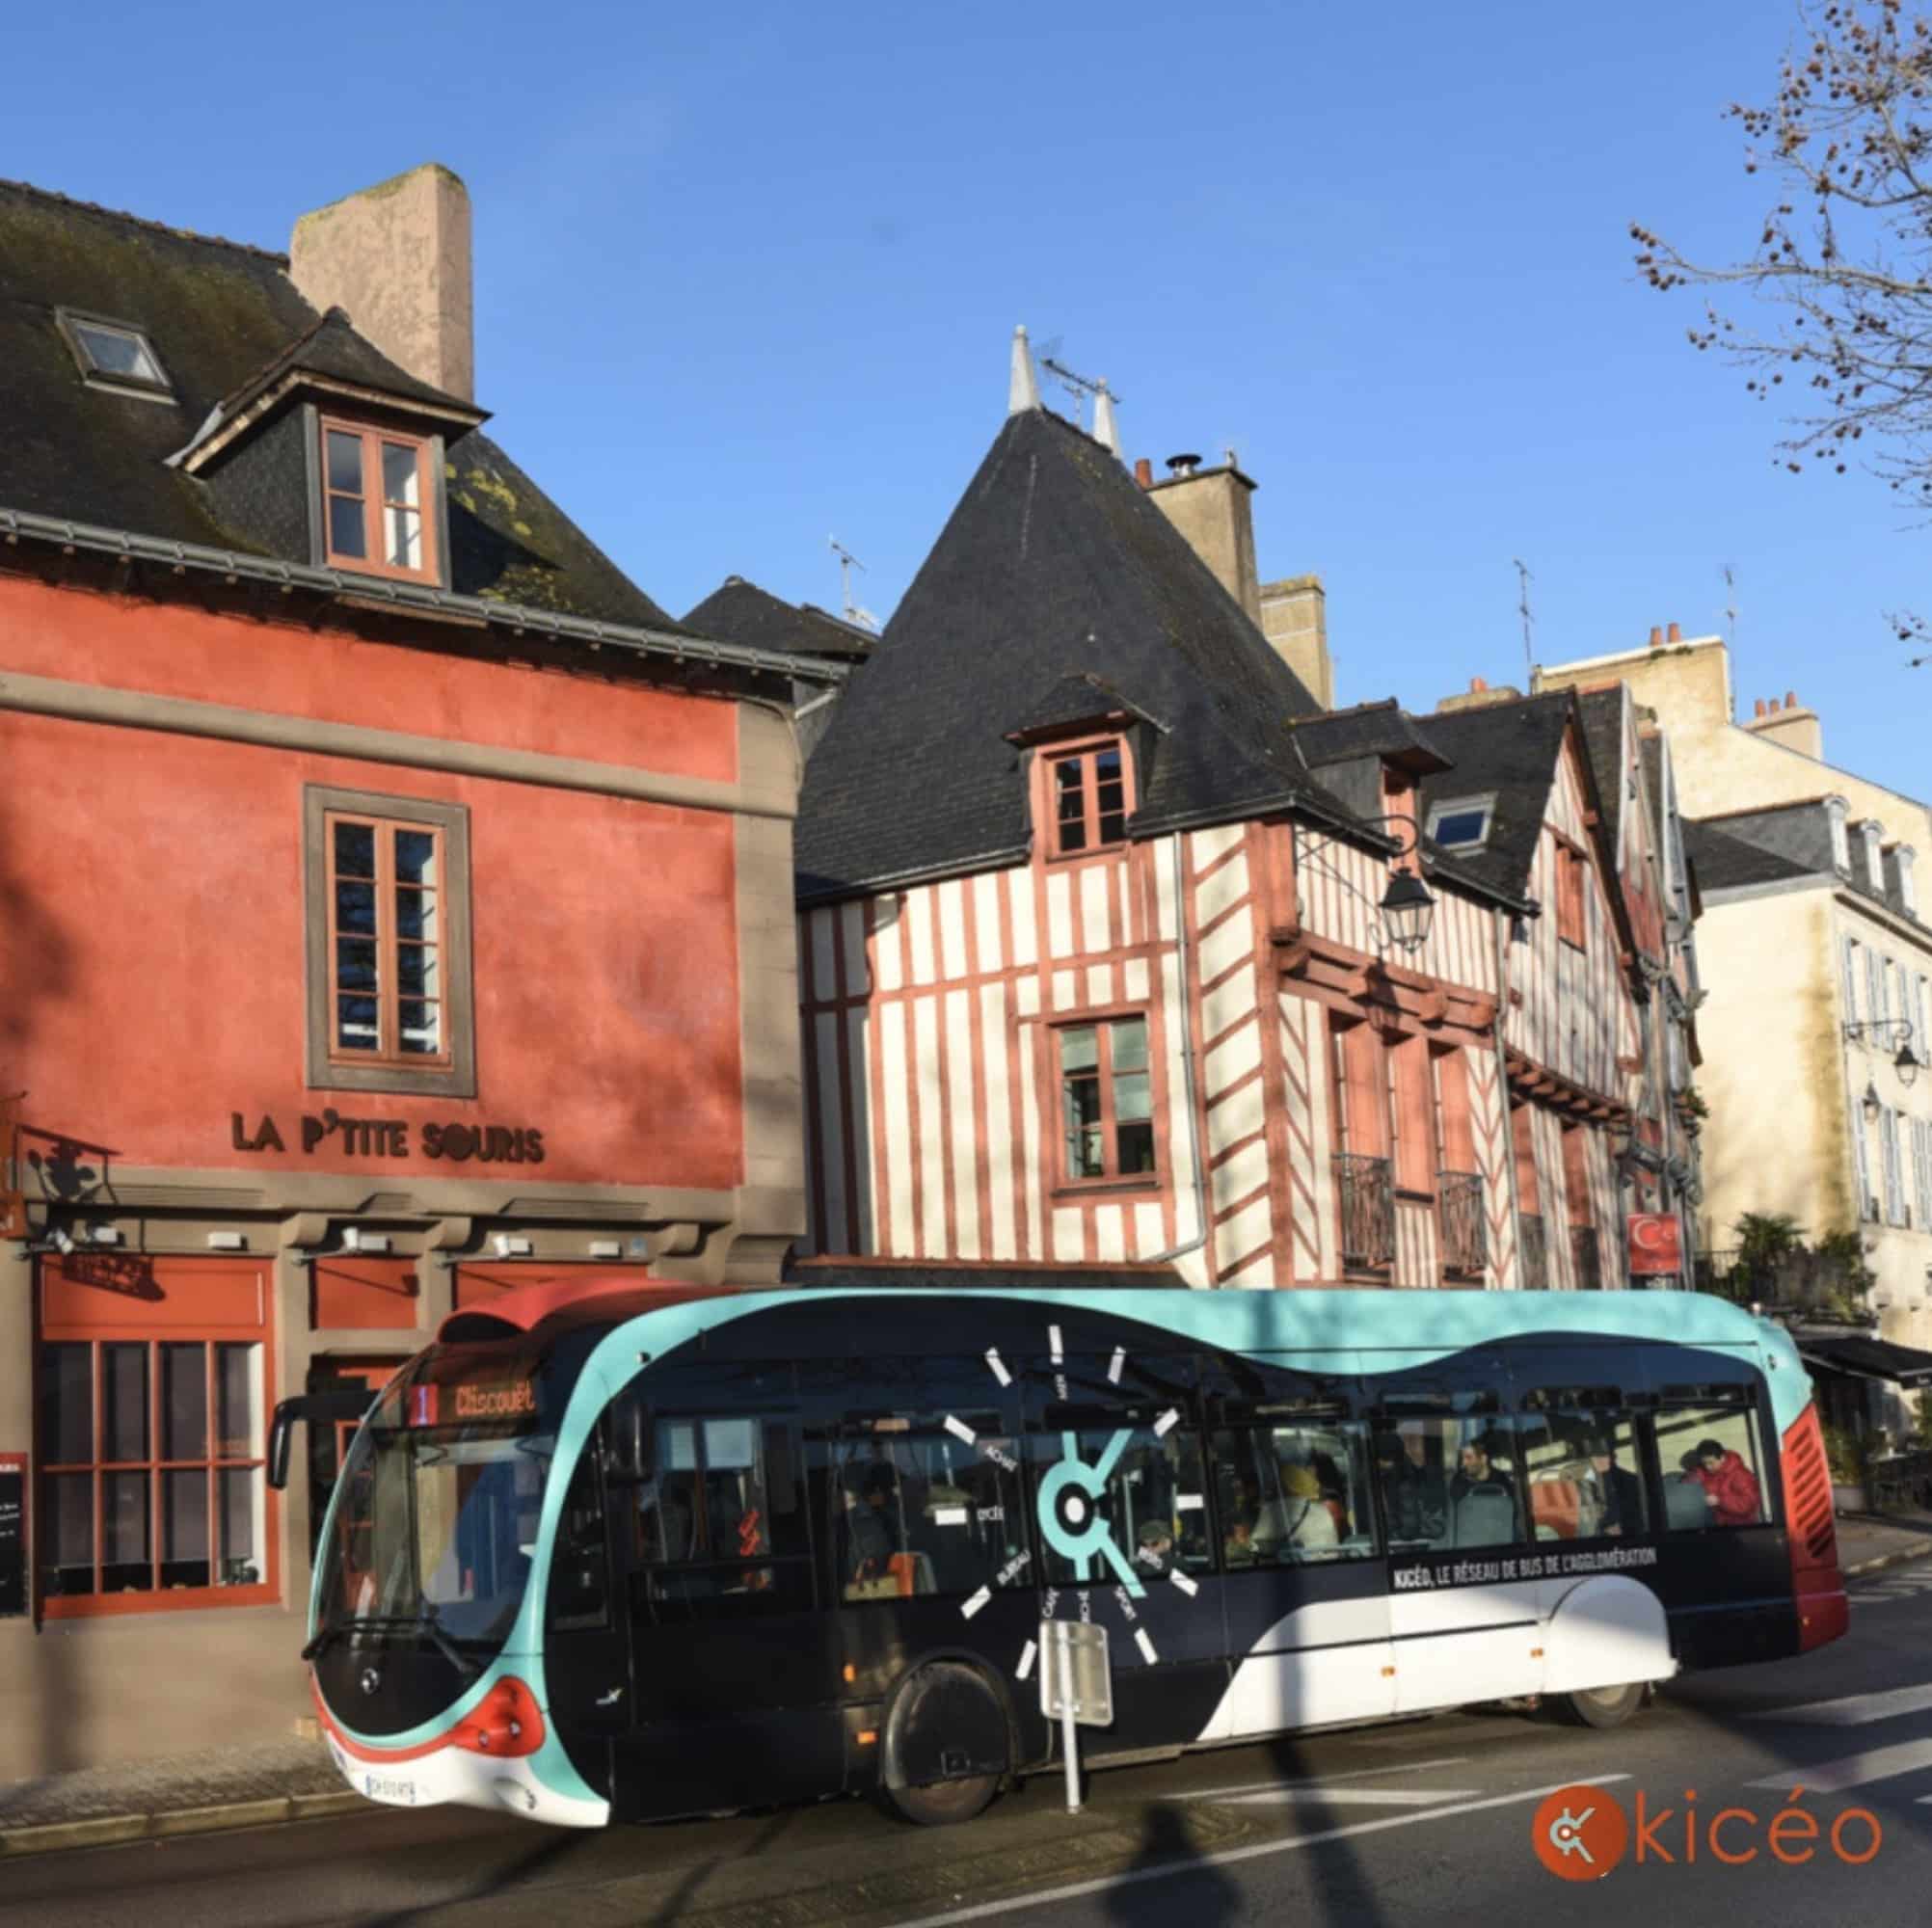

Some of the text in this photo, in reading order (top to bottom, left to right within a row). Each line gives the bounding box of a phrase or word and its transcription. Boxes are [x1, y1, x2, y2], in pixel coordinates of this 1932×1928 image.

[231, 1111, 286, 1153] LA
[421, 1122, 546, 1164] SOURIS
[417, 1386, 429, 1425] 1
[1436, 1565, 1451, 1586] LE
[1453, 1560, 1500, 1584] RÉSEAU
[1502, 1559, 1517, 1579] DE
[1519, 1557, 1543, 1577] BUS
[1544, 1555, 1561, 1574] DE
